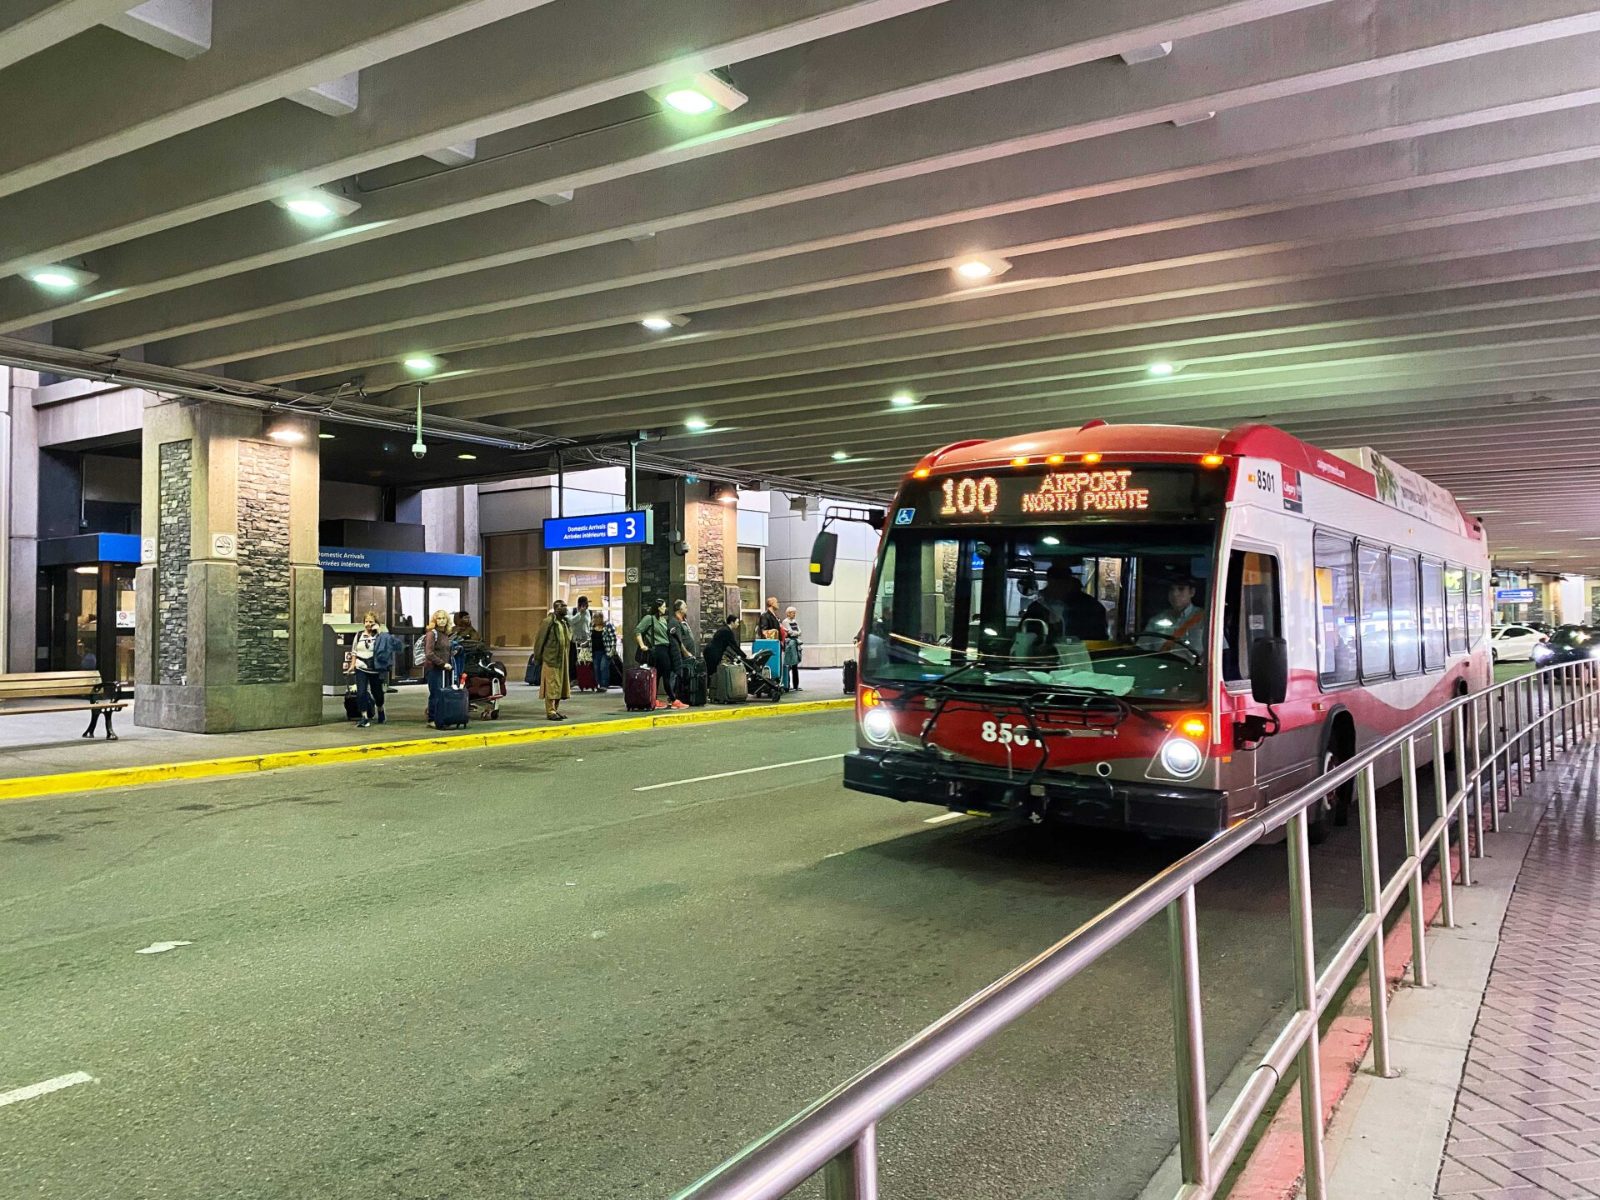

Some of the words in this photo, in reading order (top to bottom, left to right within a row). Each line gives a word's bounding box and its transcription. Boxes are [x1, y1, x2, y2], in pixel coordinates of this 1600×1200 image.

[1040, 470, 1132, 492] AIRPORT
[1257, 469, 1275, 493] 8501
[941, 477, 998, 514] 100
[1022, 492, 1077, 512] NORTH
[1083, 489, 1149, 510] POINTE
[624, 518, 636, 538] 3
[982, 721, 1042, 748] 850
